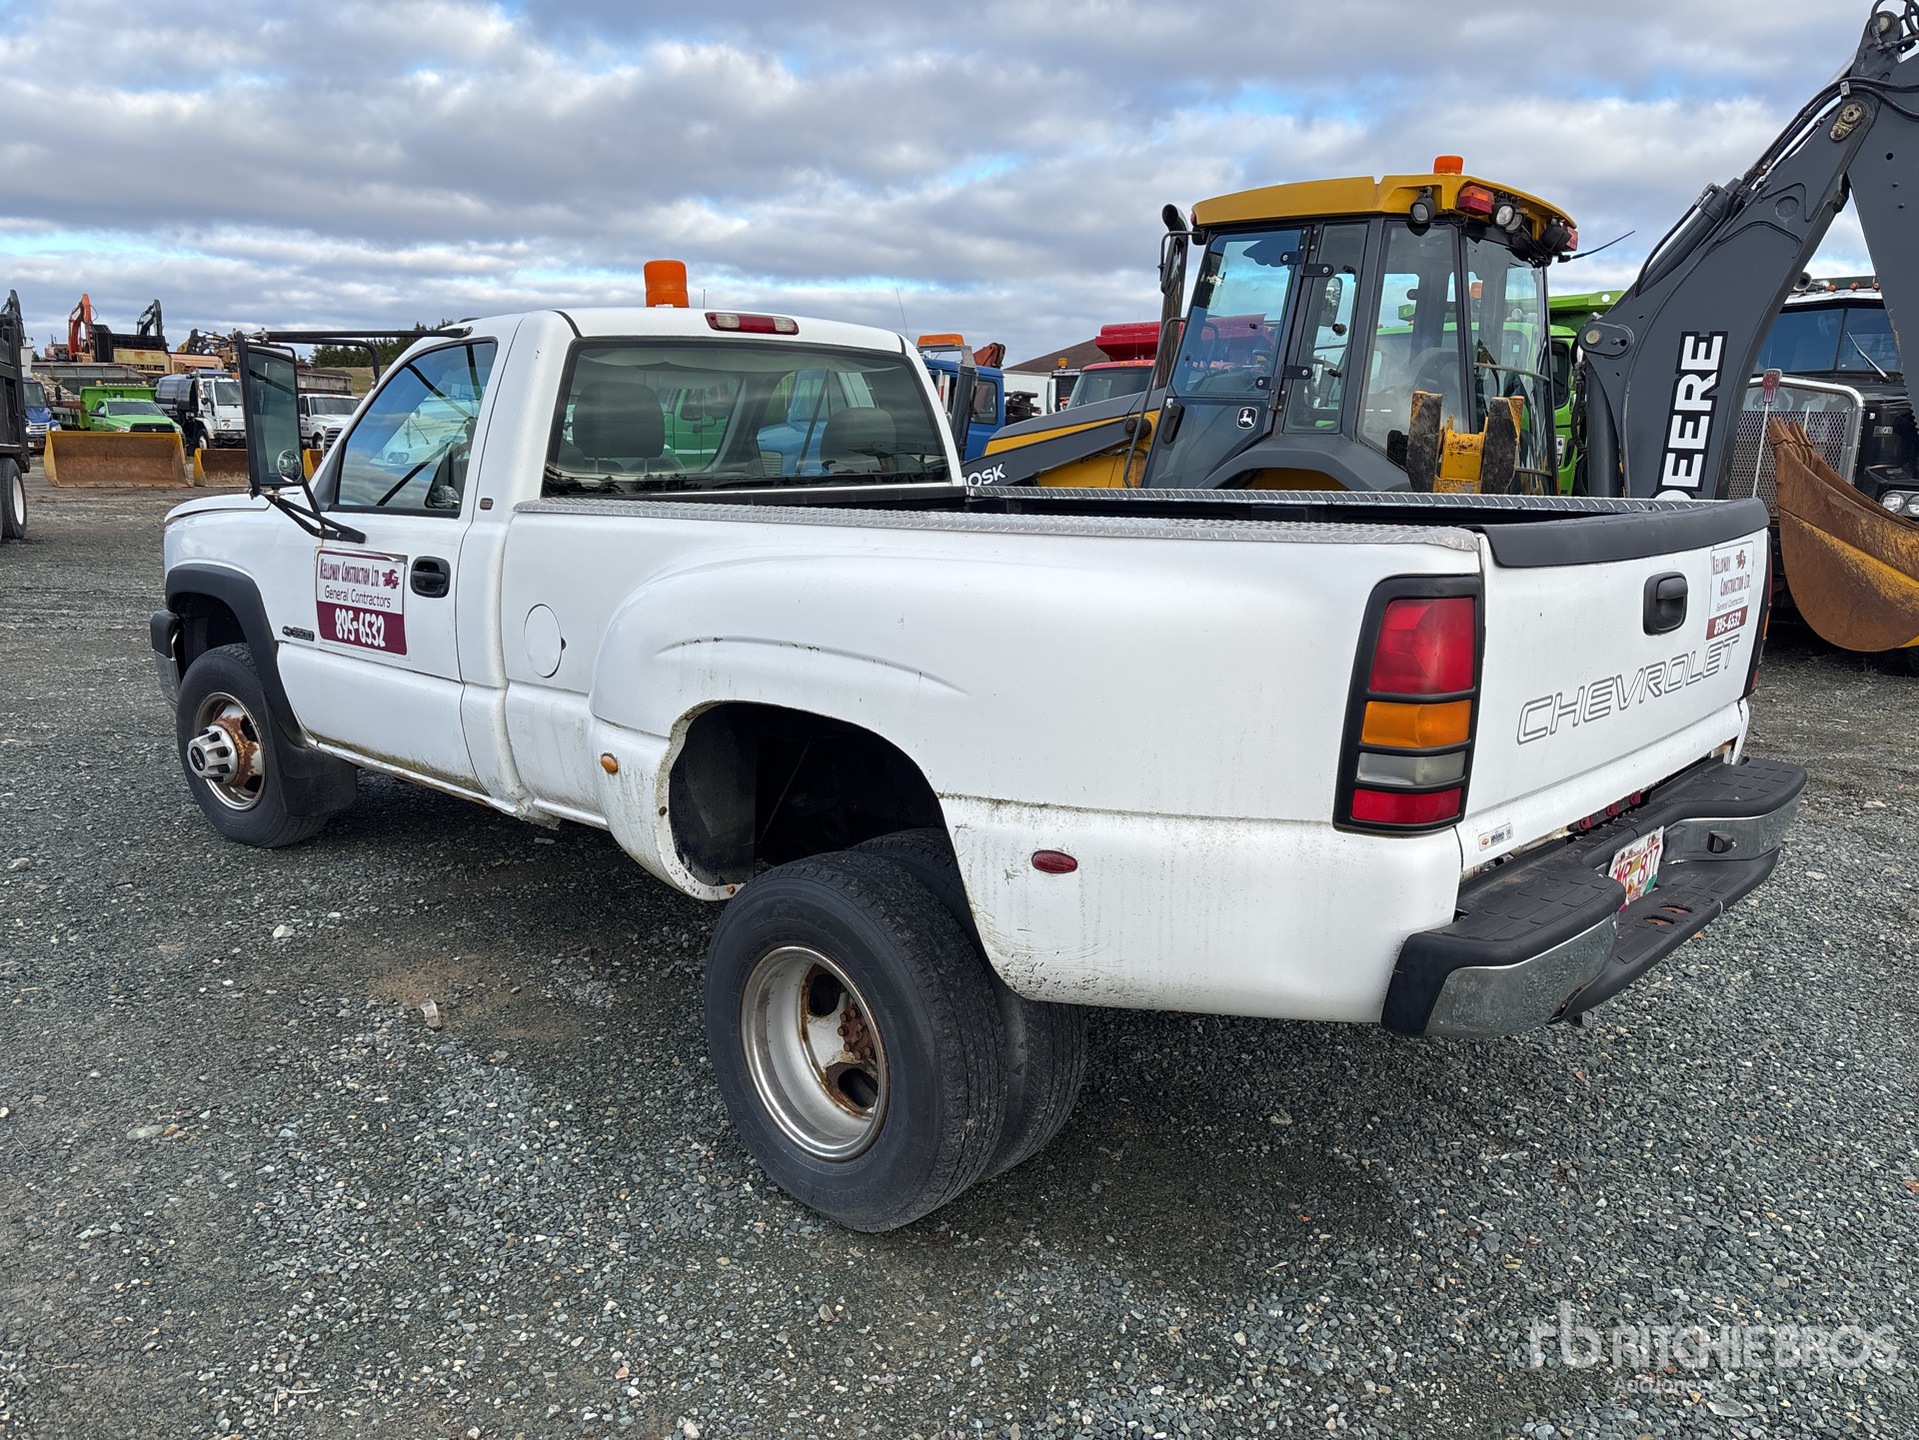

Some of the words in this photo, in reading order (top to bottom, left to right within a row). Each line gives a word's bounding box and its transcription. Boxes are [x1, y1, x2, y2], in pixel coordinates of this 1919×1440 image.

[1654, 335, 1724, 500] EERE
[325, 584, 349, 602] General
[351, 588, 391, 608] Contractors
[334, 608, 386, 647] 895-6532
[1713, 610, 1742, 635] 895-6532
[1516, 634, 1740, 745] CHEVROLET
